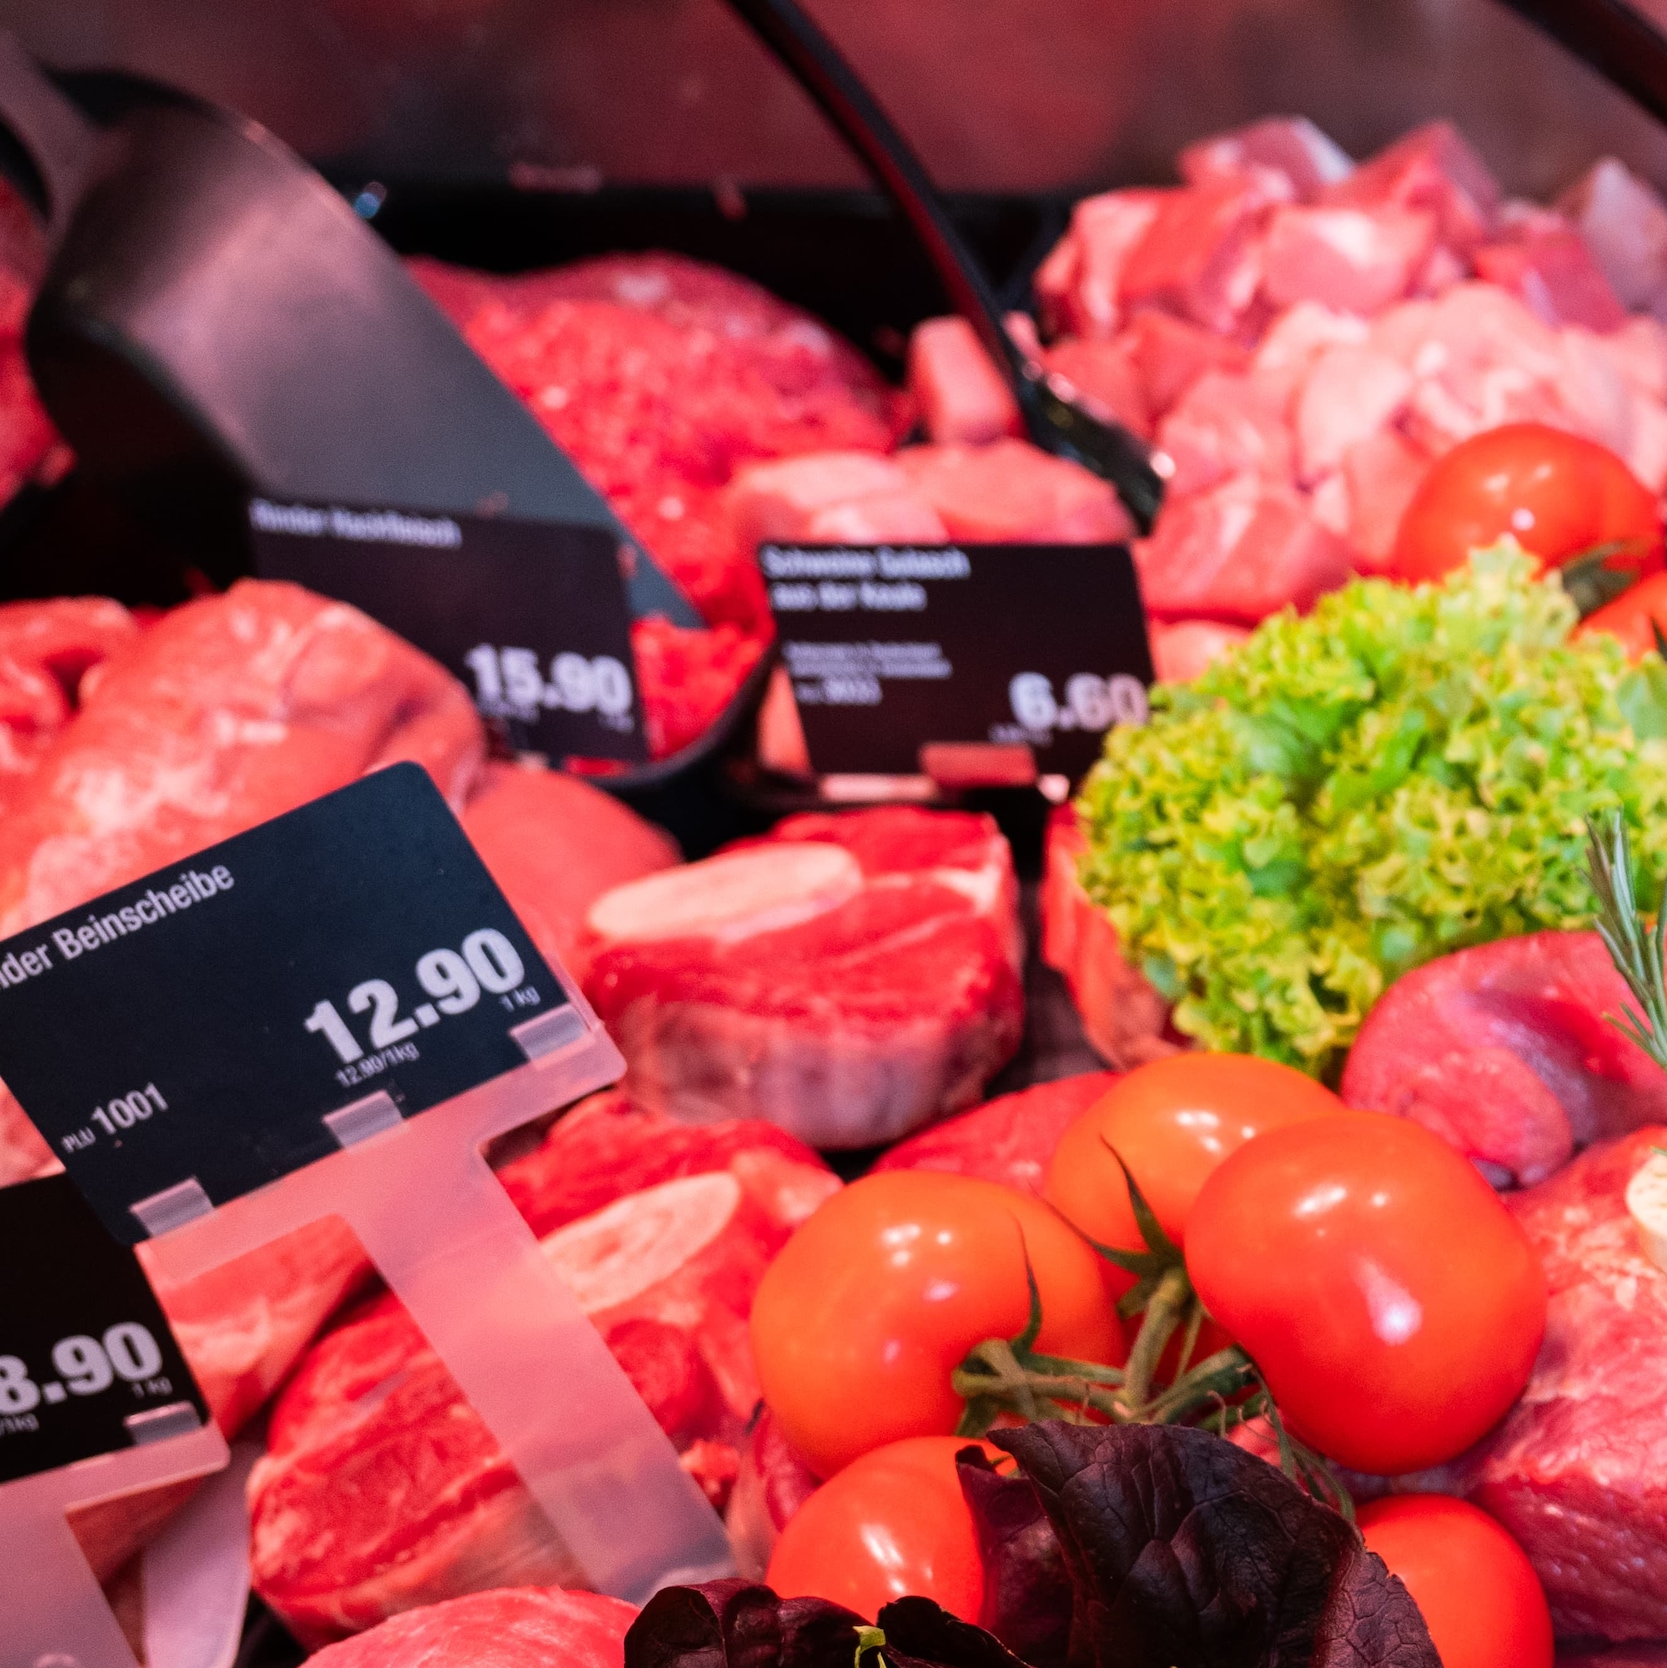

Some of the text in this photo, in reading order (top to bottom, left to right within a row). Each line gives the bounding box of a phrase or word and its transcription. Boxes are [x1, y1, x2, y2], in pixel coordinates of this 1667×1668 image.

[465, 643, 632, 714] 15.90
[1009, 672, 1149, 732] 6.60
[51, 862, 235, 961] Beinscheibe
[303, 927, 526, 1066] 12.90
[514, 984, 541, 1012] kg
[335, 1040, 421, 1089] 12.90/1kg
[61, 1082, 169, 1154] PLU 1001
